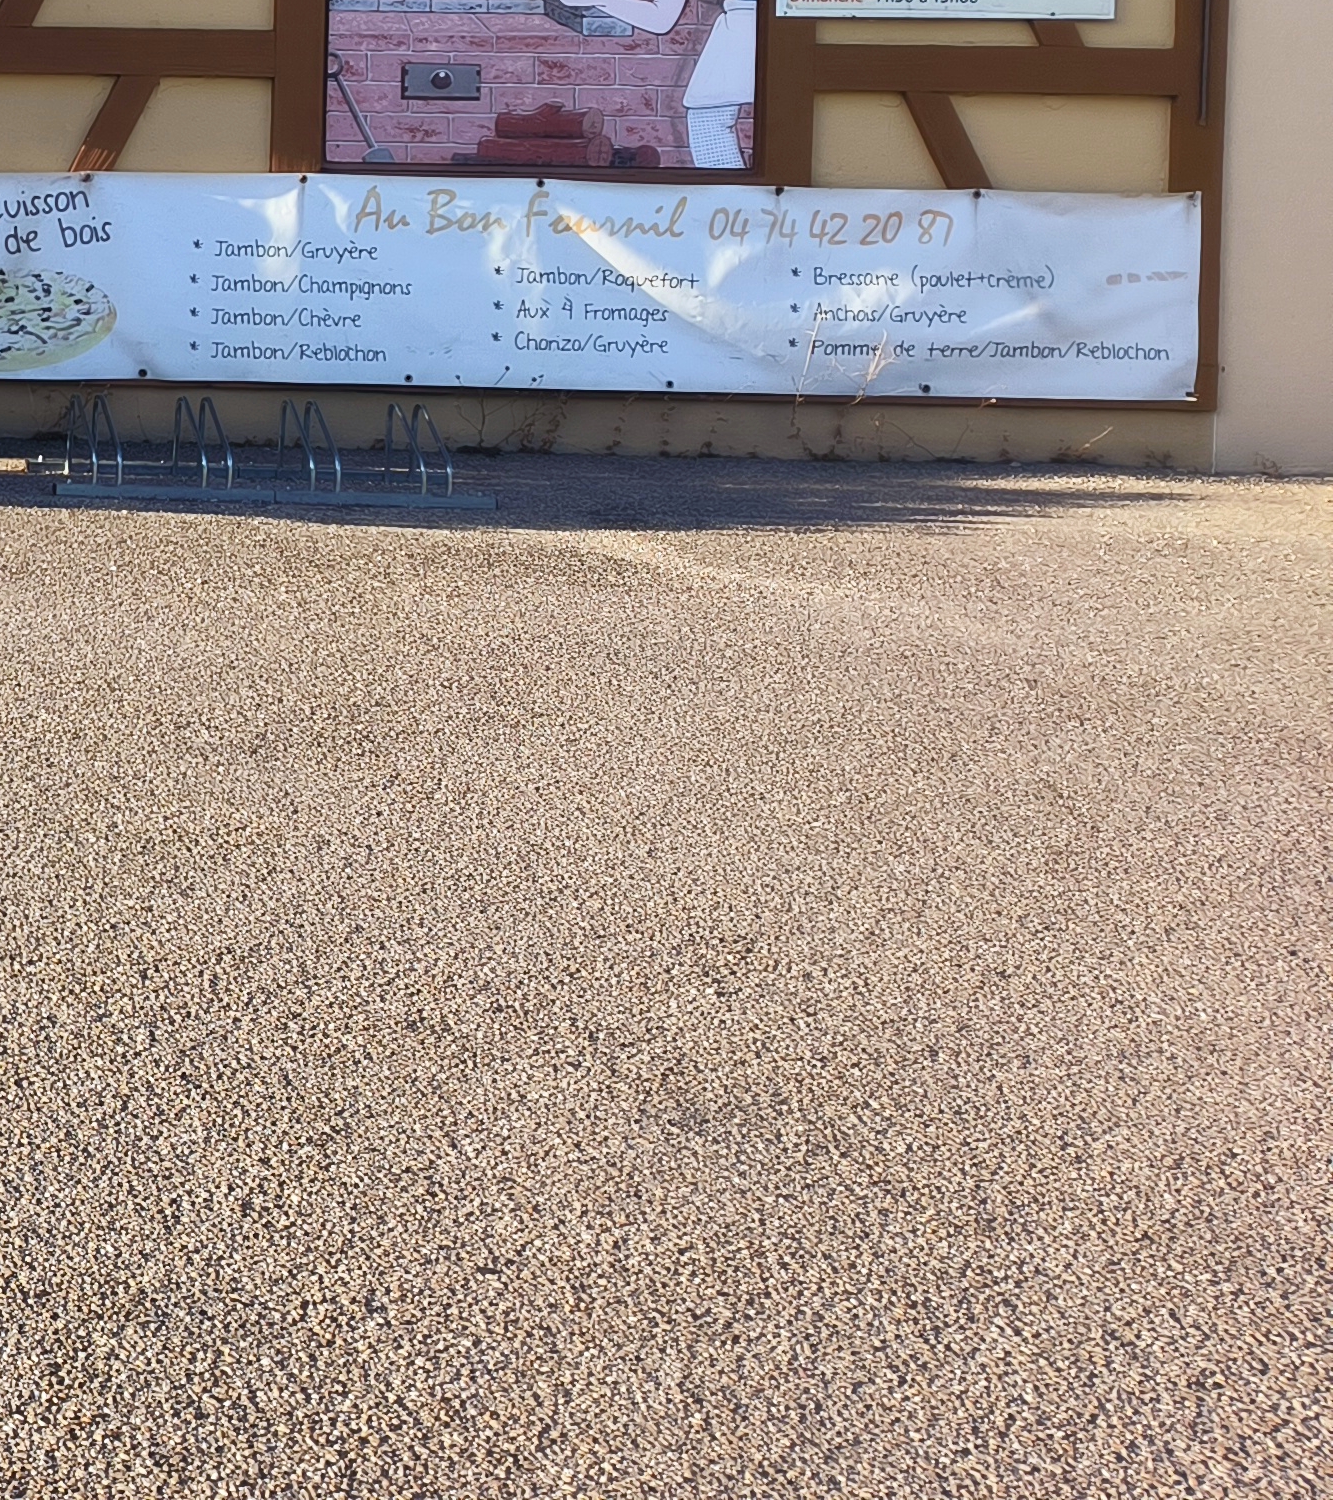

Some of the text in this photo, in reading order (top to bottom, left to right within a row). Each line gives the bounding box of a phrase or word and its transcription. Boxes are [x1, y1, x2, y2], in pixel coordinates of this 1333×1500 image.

[354, 185, 411, 235] Au
[426, 188, 507, 236] Bon
[707, 207, 751, 247] 04
[760, 207, 799, 248] 74
[808, 209, 850, 248] 42
[859, 210, 904, 247] 20
[917, 208, 954, 248] 87
[4, 227, 43, 257] de
[59, 218, 113, 249] bois
[213, 238, 380, 265] Jambon/Gruyère
[210, 273, 413, 300] Jambon/Champignons
[515, 266, 701, 293] Jambon/Roquefort
[813, 266, 900, 288] Bressane
[210, 306, 362, 330] Jambon/Chèvre
[583, 303, 670, 327] Fromages
[813, 302, 968, 328] Anchois/Gruyère
[210, 340, 387, 363] Jambon/Reblochon
[514, 330, 670, 358] Chorizo/Gruyère
[893, 340, 916, 357] de
[926, 339, 1171, 362] terre/Jambon/Reblochon
